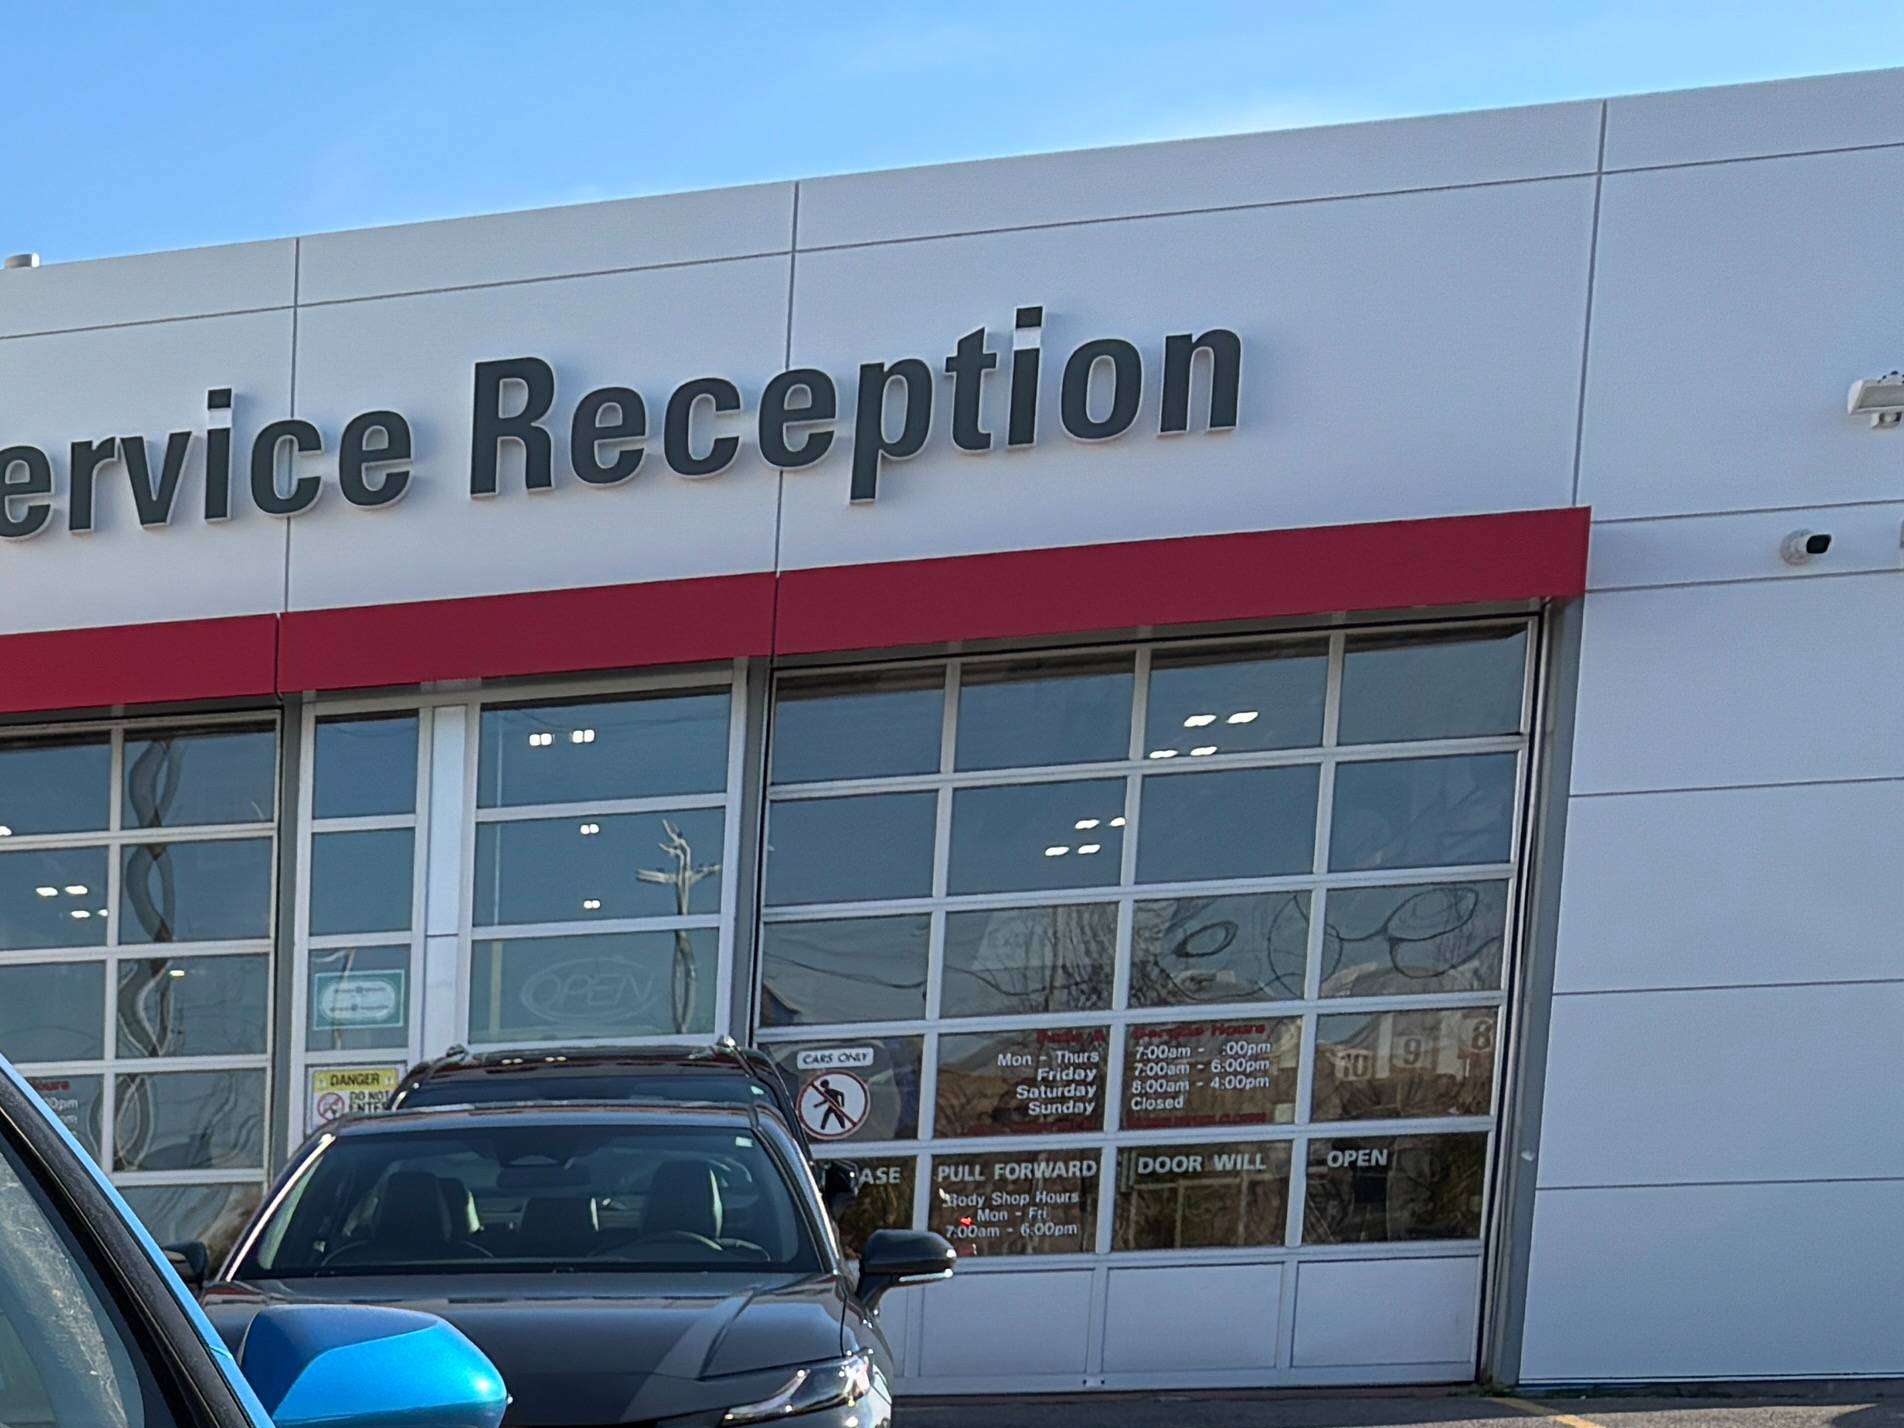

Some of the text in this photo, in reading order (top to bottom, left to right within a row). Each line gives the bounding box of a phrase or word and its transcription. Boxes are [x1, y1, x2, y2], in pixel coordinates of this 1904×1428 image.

[471, 306, 1242, 503] Reception
[531, 972, 655, 1006] OPEN
[1471, 1020, 1491, 1049] 8
[803, 1051, 869, 1065] CARS ONLY
[997, 1053, 1032, 1066] Mon
[1056, 1050, 1099, 1063] Thurs
[1135, 1045, 1191, 1060] 7:00am
[1403, 1038, 1422, 1065] 9
[330, 1072, 380, 1086] DANGER
[1037, 1067, 1097, 1081] Friday
[1134, 1062, 1190, 1076] 7:00am
[1210, 1058, 1270, 1073] 6:00pm
[350, 1090, 390, 1103] DO NOT
[1016, 1083, 1096, 1099] Saturday
[1132, 1079, 1190, 1093] 8:00am
[1210, 1075, 1270, 1090] 4:00pm
[1028, 1095, 1184, 1115] Sunday Closed
[858, 1149, 1388, 1185] ASE PULL FORWARD DOOR WILL OPEN
[947, 1190, 1079, 1208] Body Shop Hours
[977, 1208, 1008, 1222] Mon
[1029, 1207, 1047, 1220] Fri
[946, 1225, 1000, 1238] 7:00am
[1020, 1222, 1078, 1237] 6:00pm
